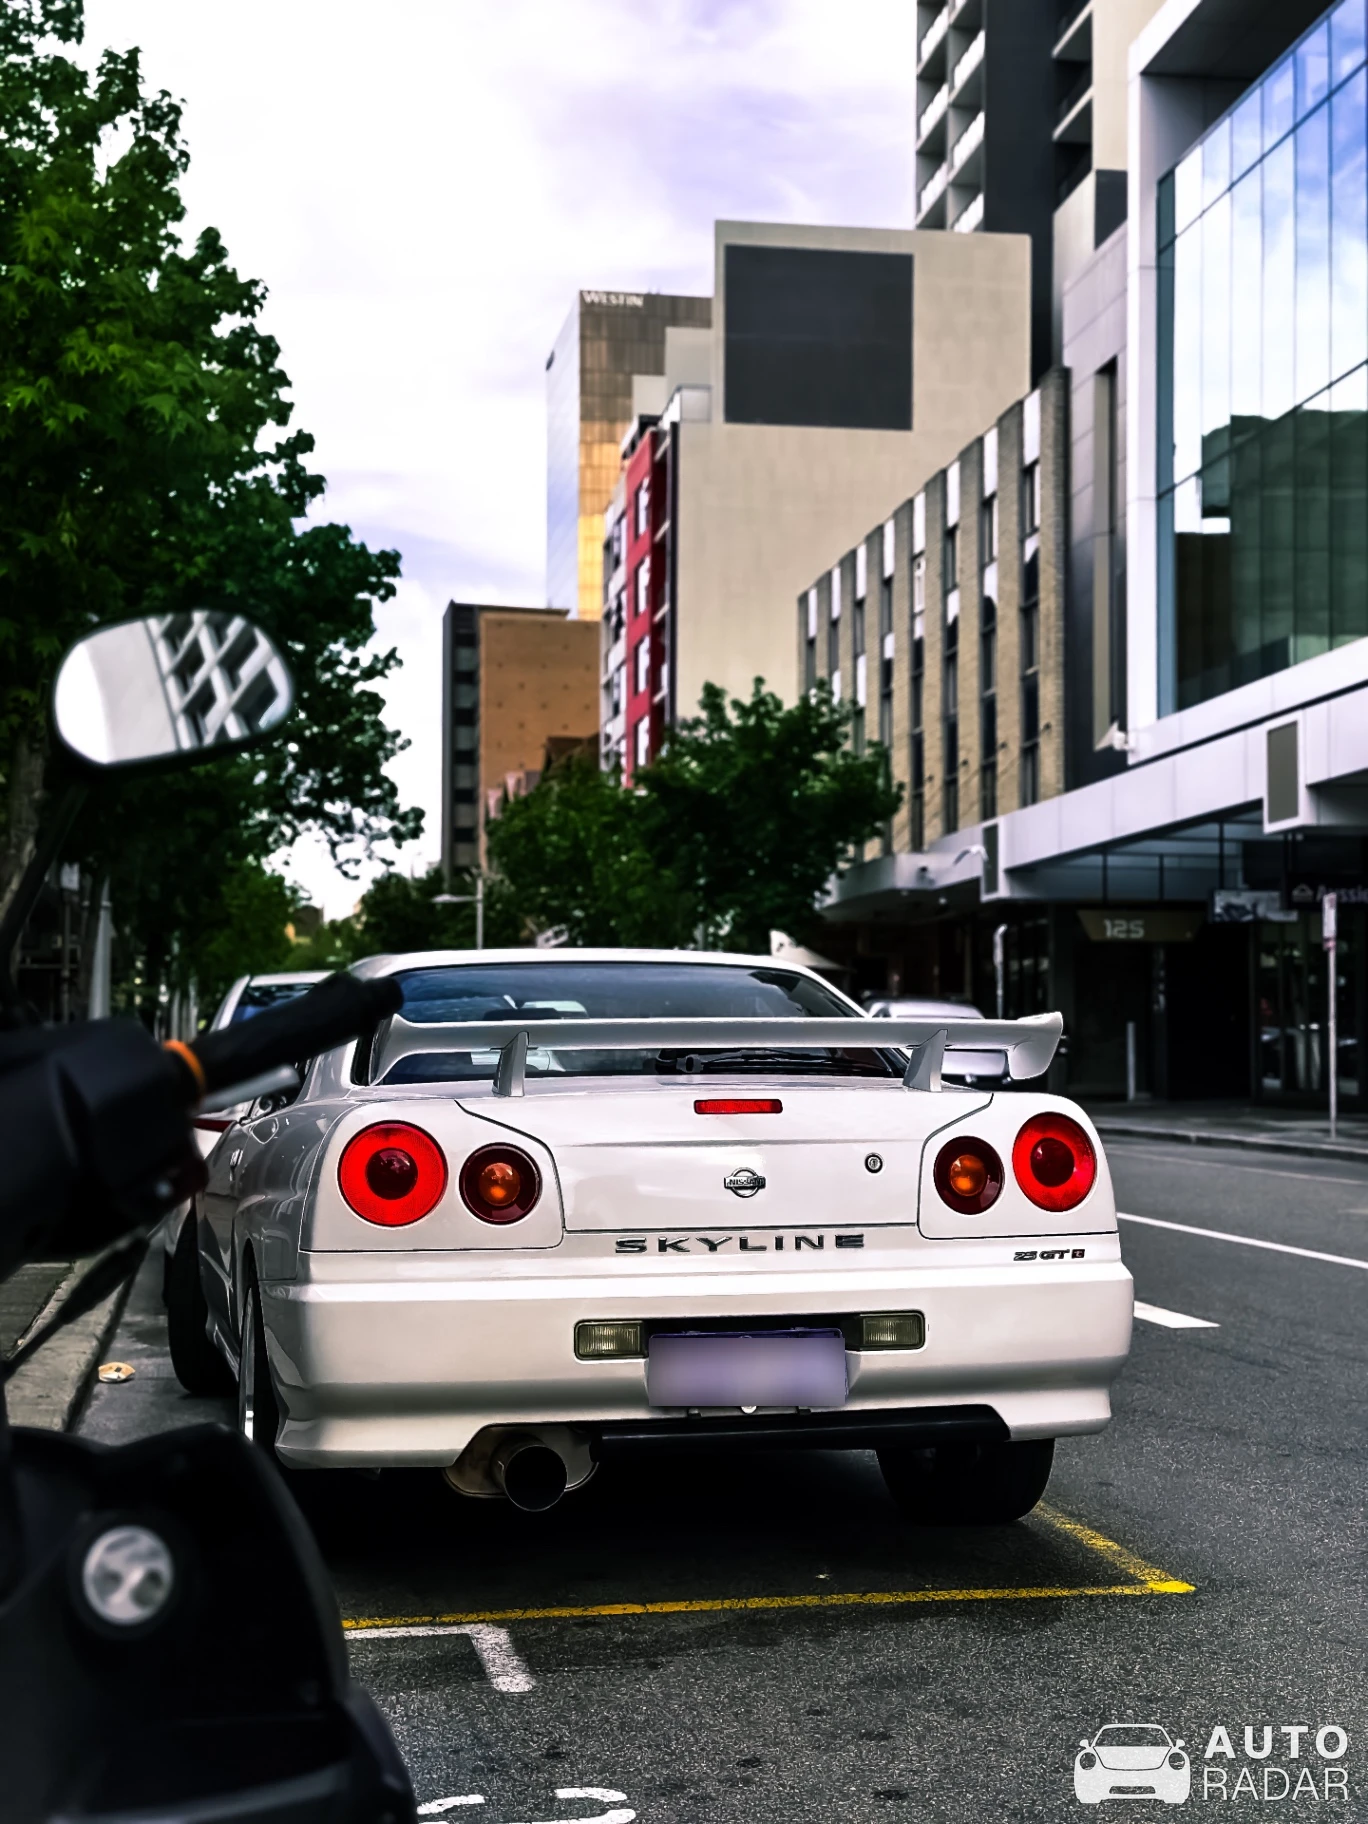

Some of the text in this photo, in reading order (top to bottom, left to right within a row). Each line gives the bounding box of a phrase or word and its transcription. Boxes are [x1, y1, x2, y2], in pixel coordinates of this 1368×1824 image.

[1104, 919, 1144, 938] 125
[729, 1177, 765, 1187] NISSAN
[615, 1234, 864, 1253] SKYLINE
